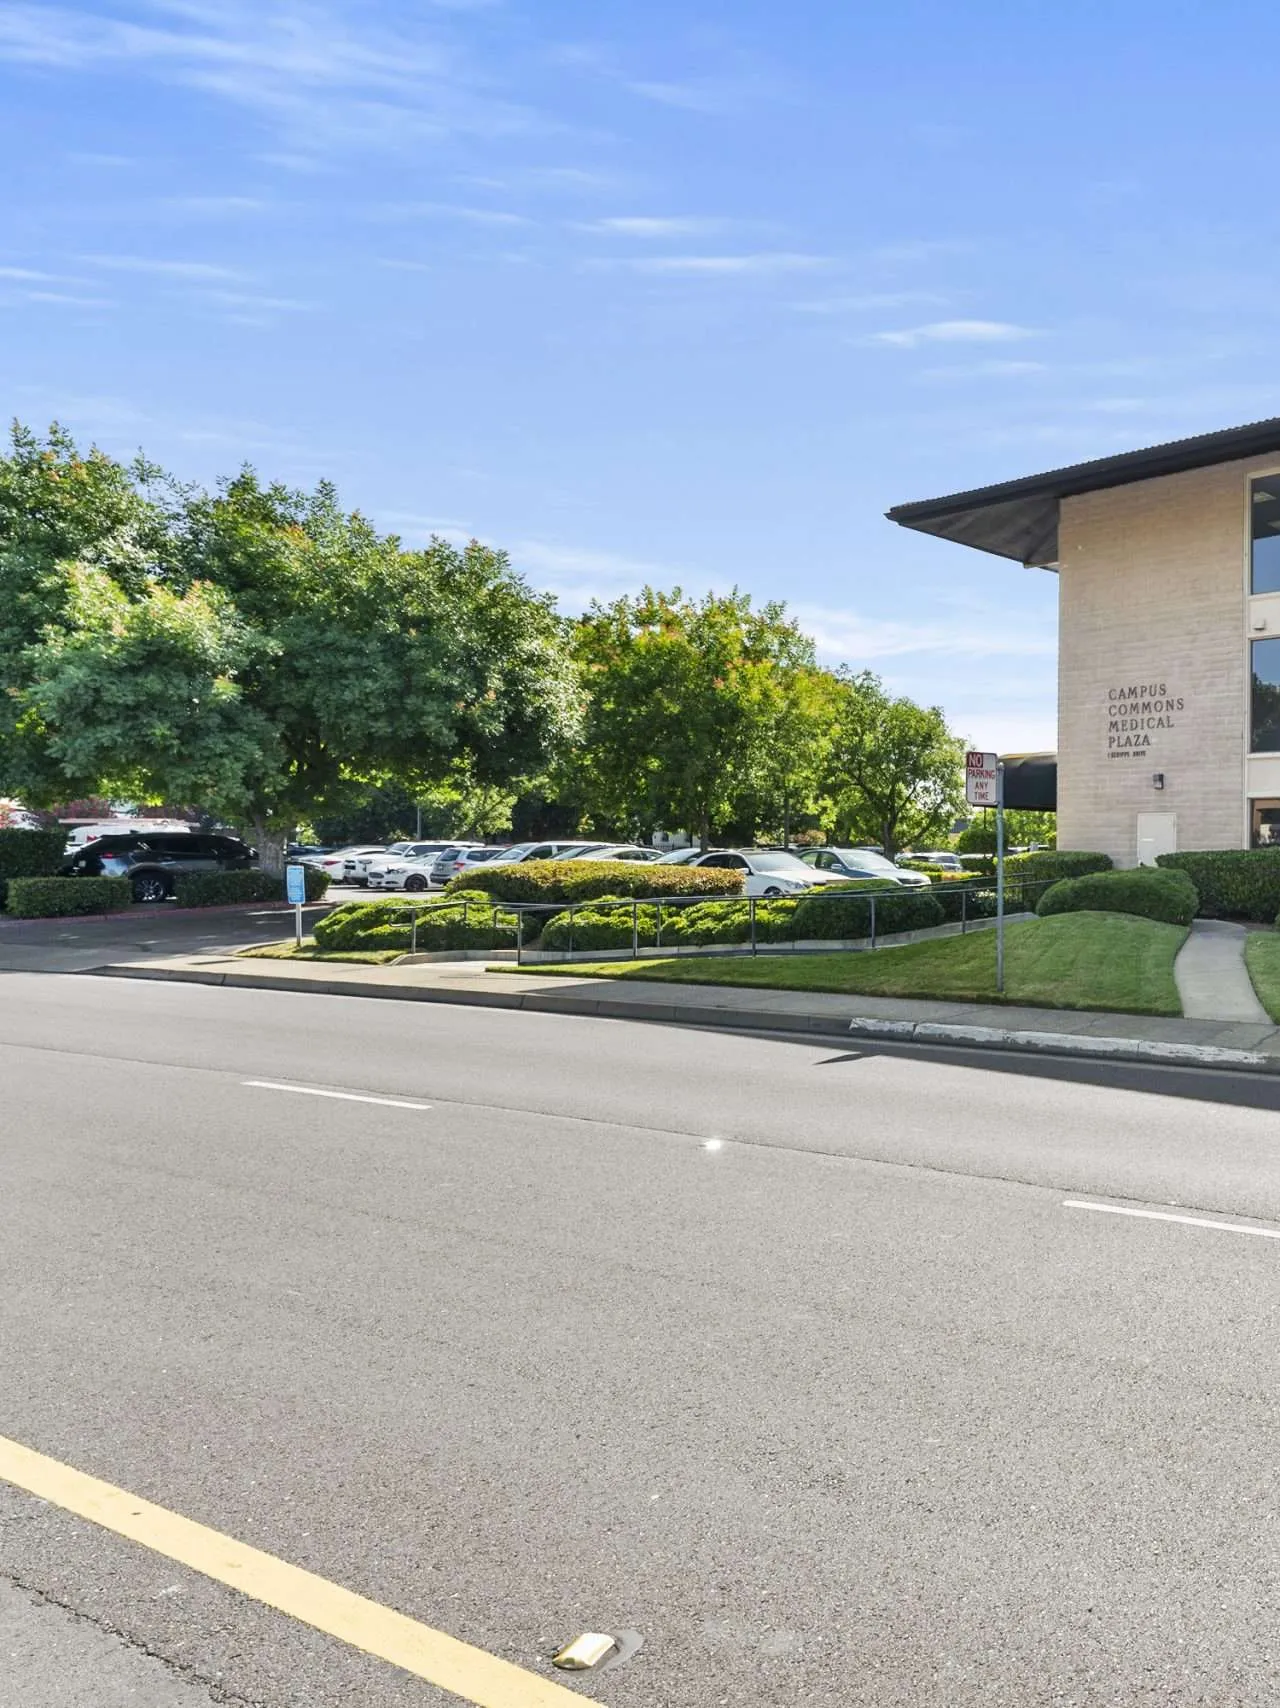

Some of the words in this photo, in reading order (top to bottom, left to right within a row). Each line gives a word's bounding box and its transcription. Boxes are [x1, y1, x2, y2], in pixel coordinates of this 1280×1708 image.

[1108, 683, 1167, 701] CAMPUS
[1108, 698, 1184, 717] COMMONS
[1108, 715, 1175, 733] MEDICAL
[1108, 734, 1151, 749] PLAZA
[968, 753, 983, 767] NO
[968, 769, 996, 780] PARKING
[975, 782, 989, 790] ANY
[974, 791, 989, 801] TIME
